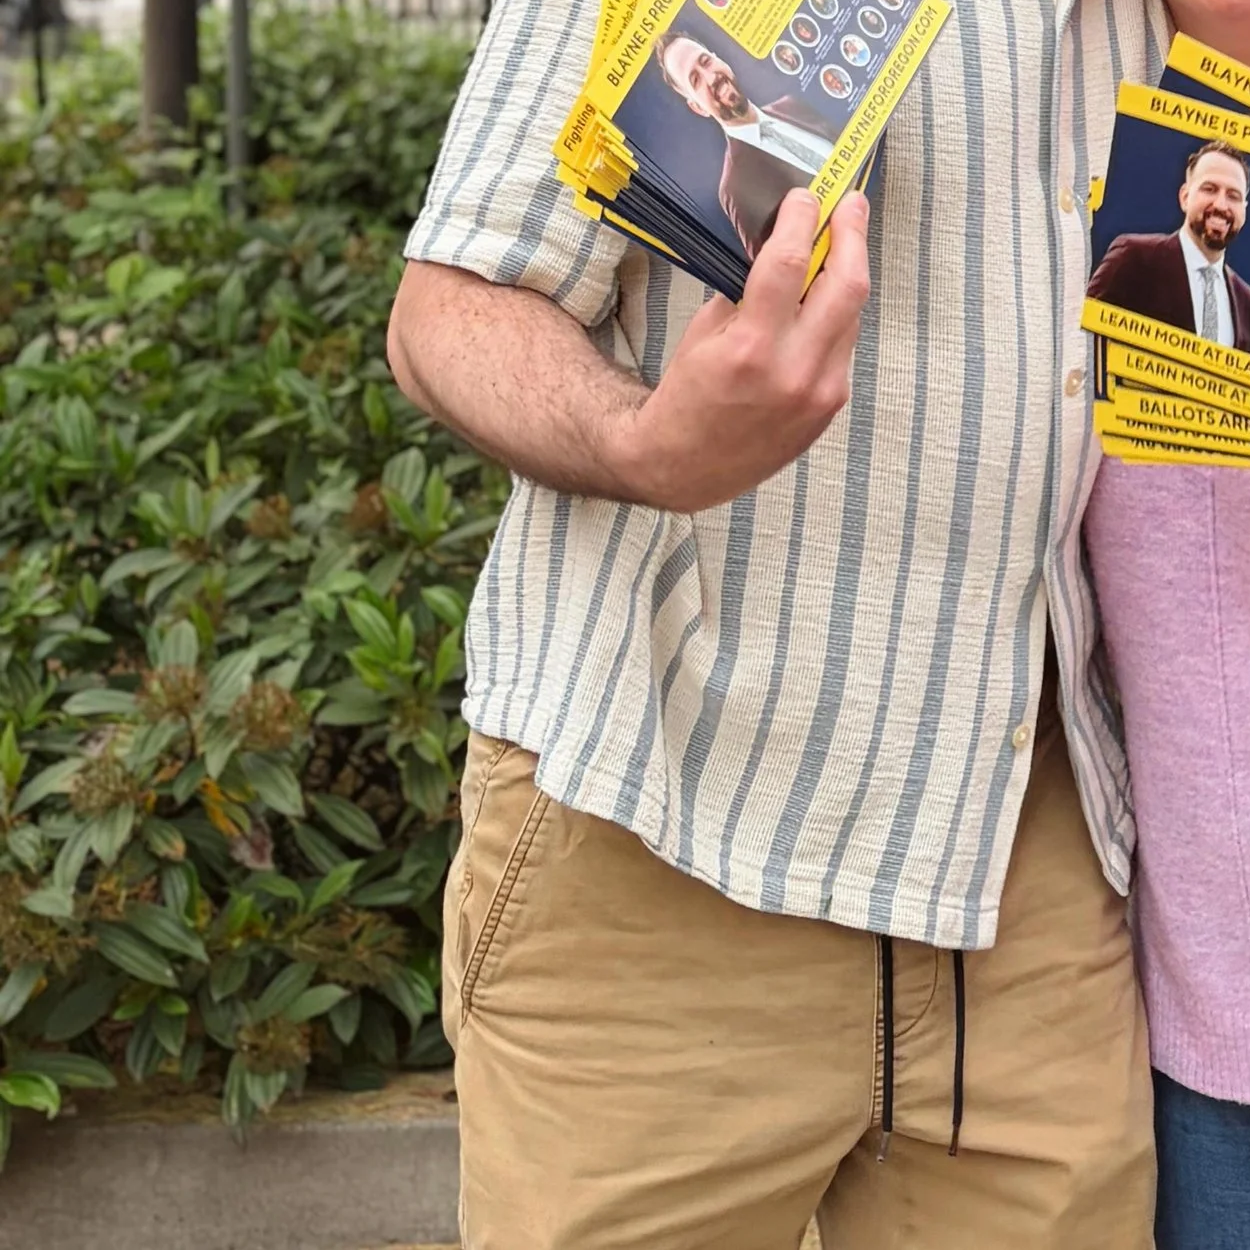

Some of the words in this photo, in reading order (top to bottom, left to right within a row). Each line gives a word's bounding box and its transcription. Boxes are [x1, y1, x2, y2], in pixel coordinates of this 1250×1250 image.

[606, 30, 648, 87] BLAYNE
[641, 17, 656, 35] IS
[563, 103, 596, 152] Fighting
[818, 175, 835, 204] RE
[831, 158, 846, 181] AT
[840, 5, 938, 162] BLAYNEFOROREGON.COM
[1150, 97, 1220, 131] BLAYNE
[1222, 118, 1239, 136] IS
[1100, 308, 1151, 339] LEARN
[1154, 328, 1200, 351] MORE
[1203, 346, 1222, 362] AT
[1125, 352, 1177, 382] LEARN
[1180, 372, 1227, 397] MORE
[1230, 389, 1249, 405] AT
[1140, 398, 1216, 426] BALLOTS
